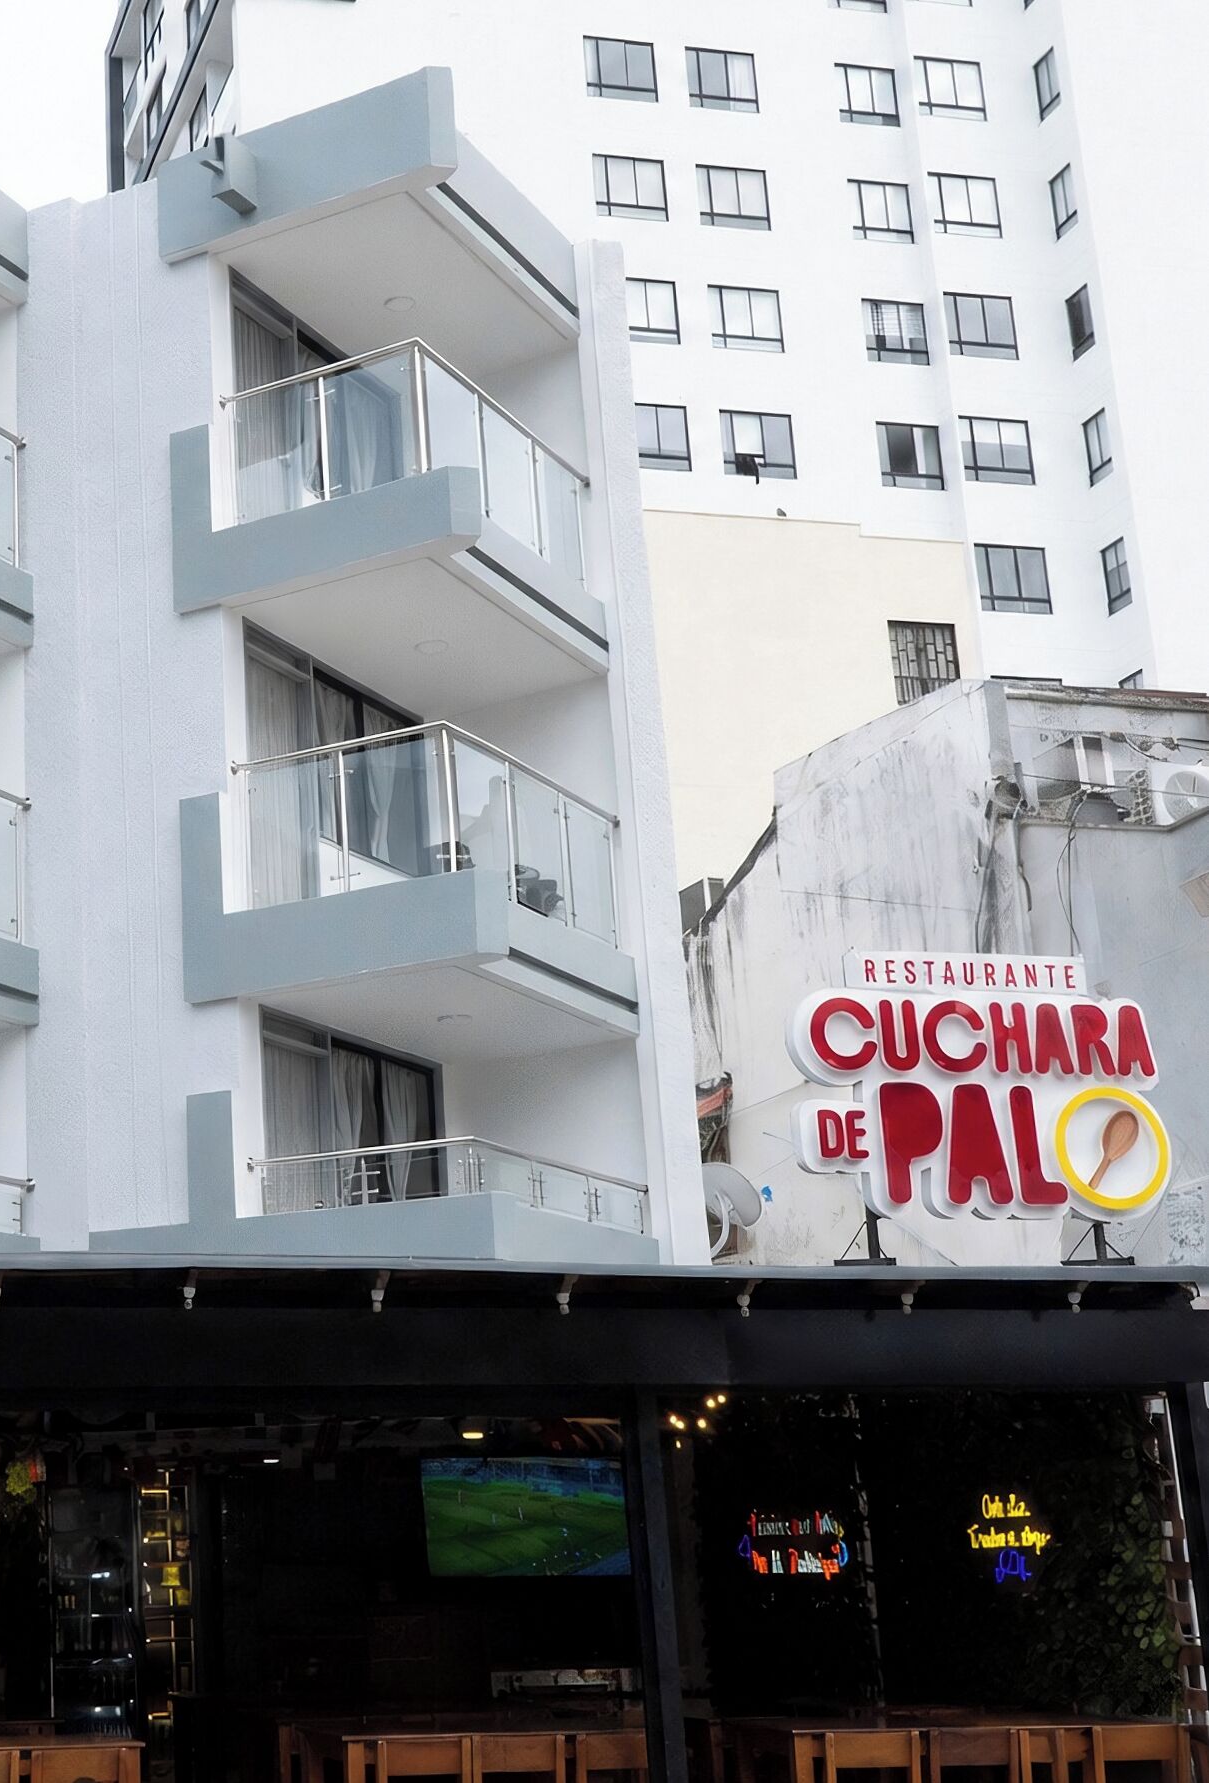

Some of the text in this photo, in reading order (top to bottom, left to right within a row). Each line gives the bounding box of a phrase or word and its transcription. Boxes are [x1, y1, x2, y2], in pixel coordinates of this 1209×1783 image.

[864, 958, 1077, 990] RESTAURANTE
[809, 997, 1157, 1078] CUCHARA
[816, 1081, 1171, 1211] DE PALO
